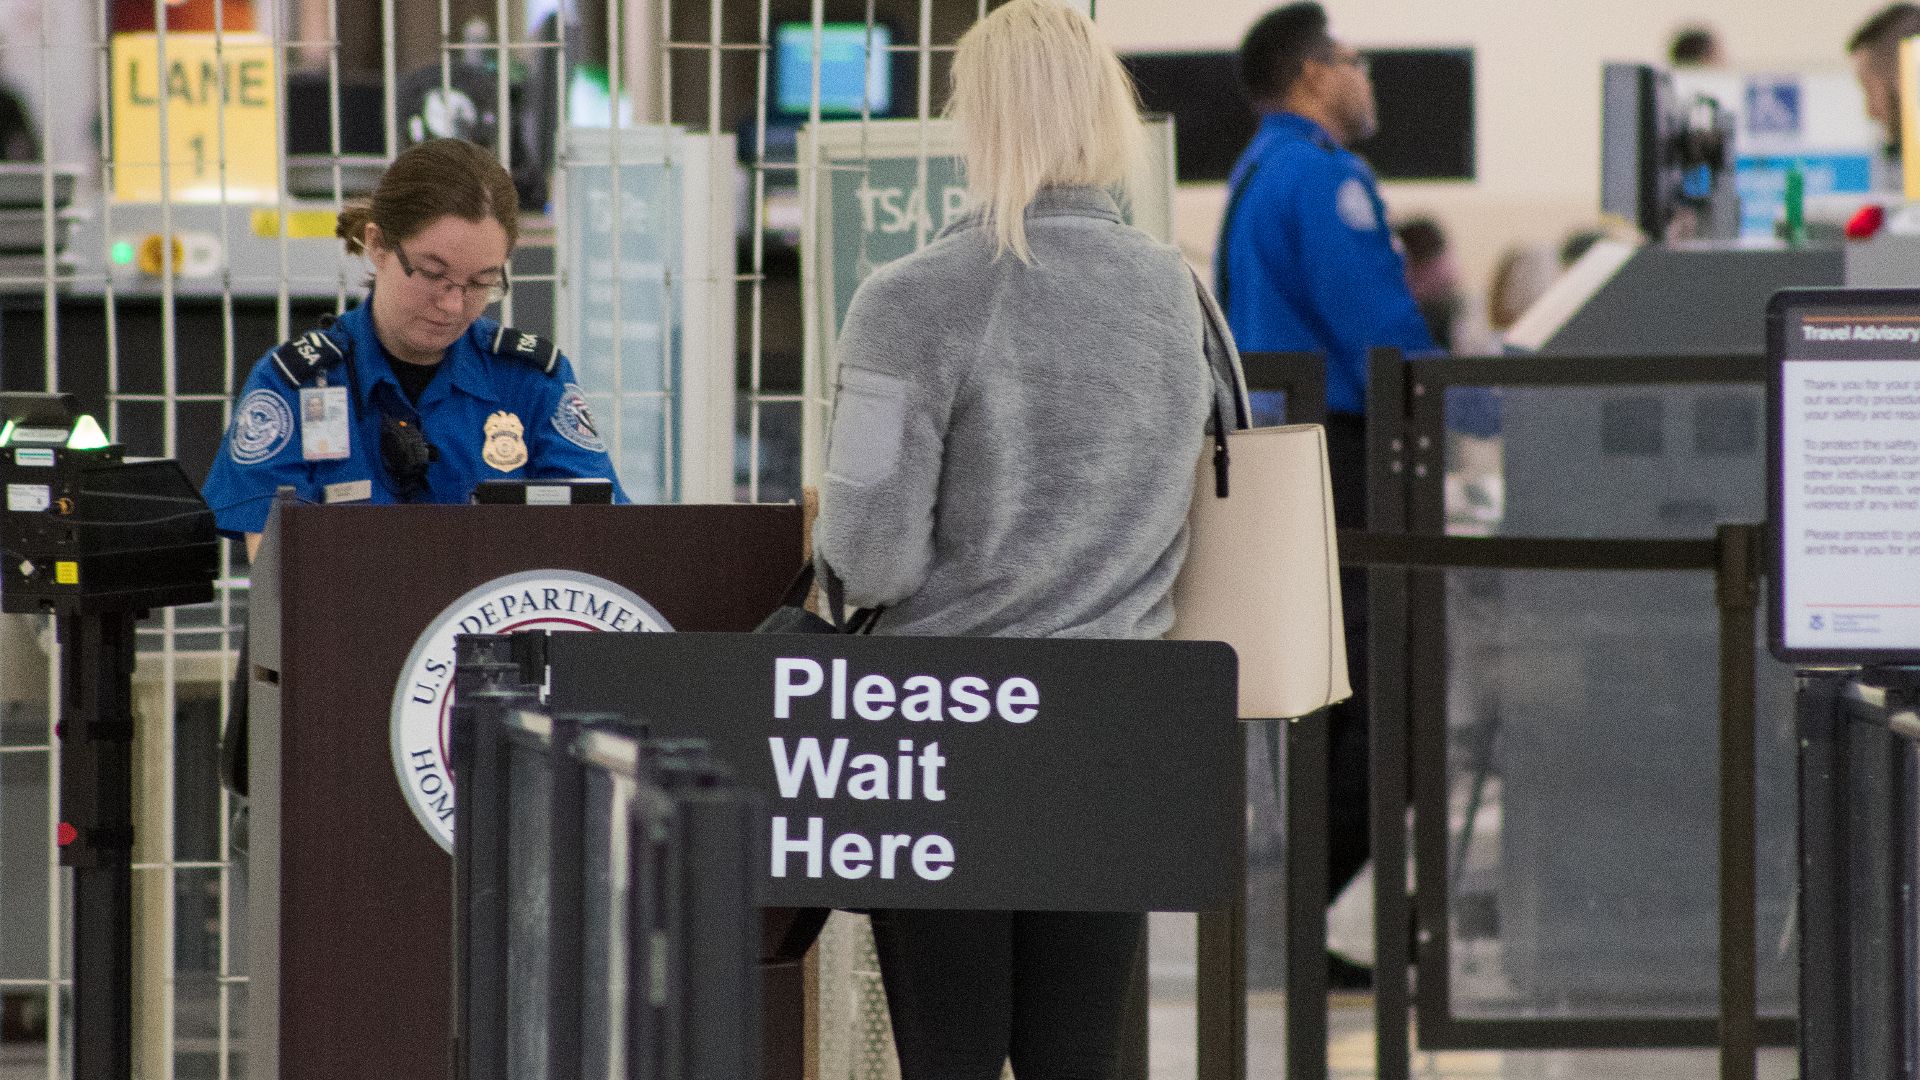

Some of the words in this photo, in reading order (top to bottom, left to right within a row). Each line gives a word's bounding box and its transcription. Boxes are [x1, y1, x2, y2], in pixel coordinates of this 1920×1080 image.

[129, 60, 267, 106] LANE
[189, 135, 205, 178] 1
[855, 187, 934, 233] TSA
[292, 336, 322, 366] TSA
[516, 333, 538, 352] TSA
[1803, 325, 1850, 341] Travel
[1853, 325, 1919, 342] Advisory
[459, 588, 654, 633] DEPARTME
[774, 657, 1040, 724] Please
[411, 748, 454, 832] HOM
[768, 737, 946, 801] Wait
[771, 816, 956, 881] Here
